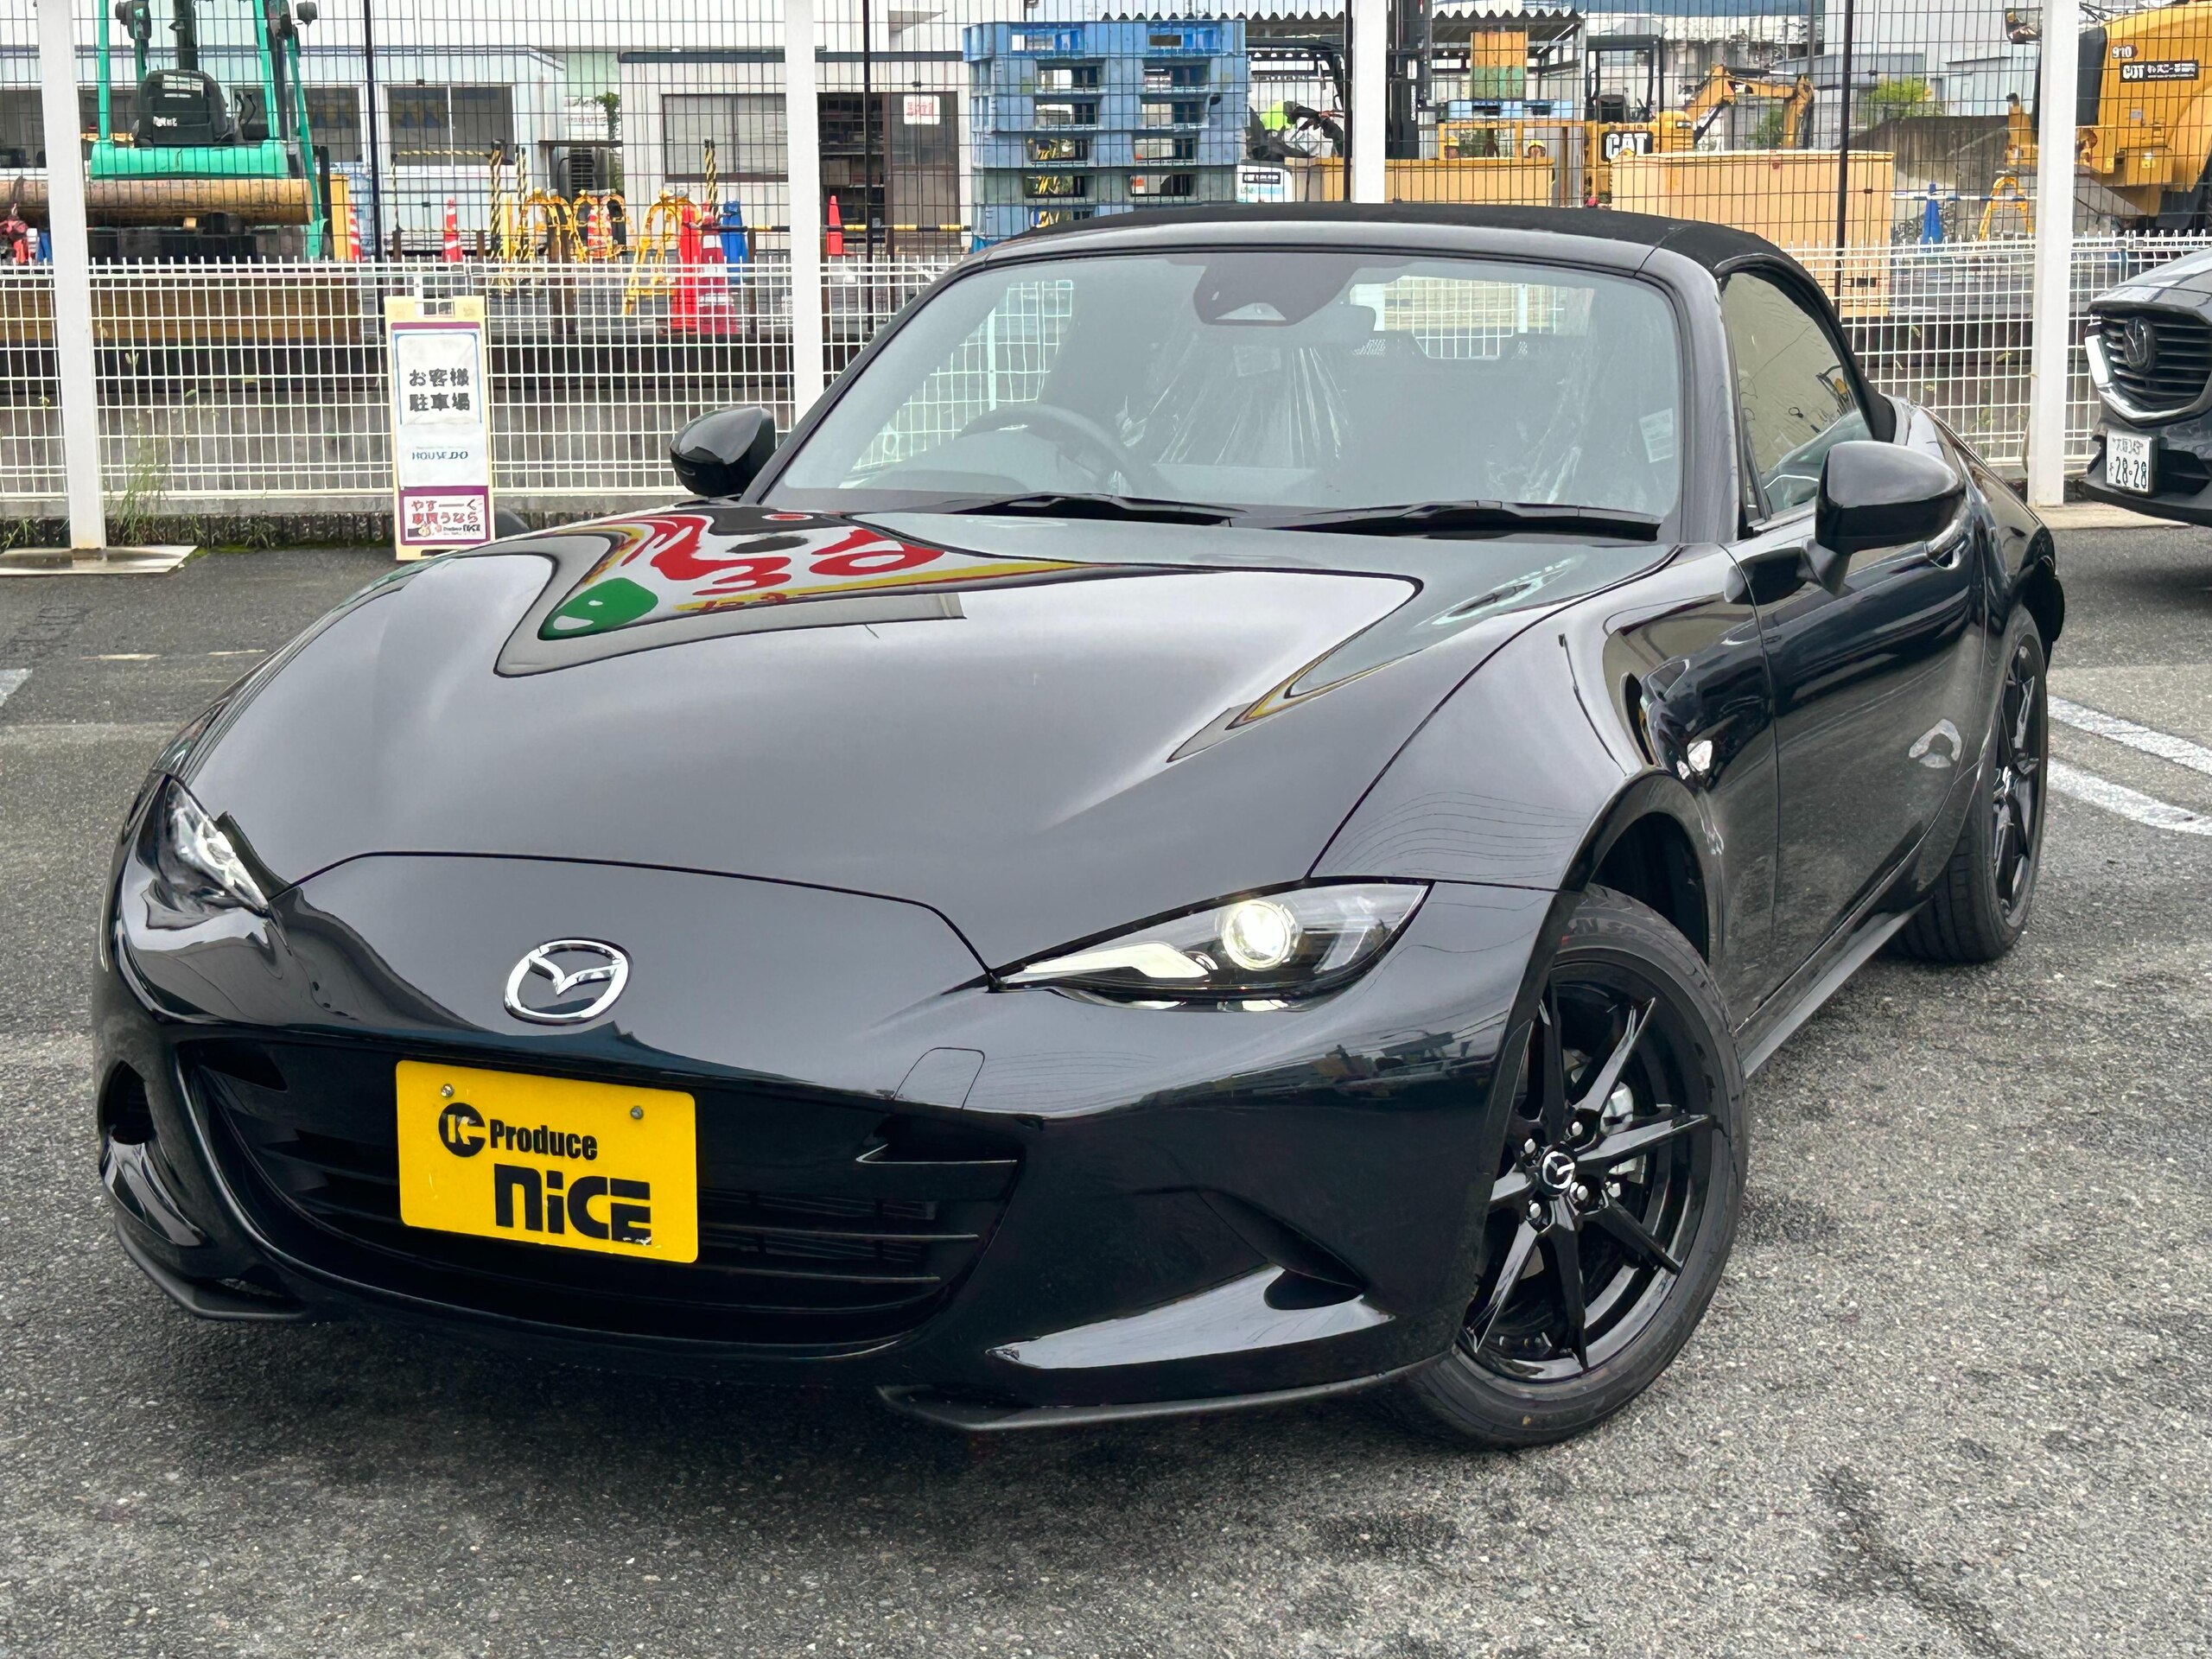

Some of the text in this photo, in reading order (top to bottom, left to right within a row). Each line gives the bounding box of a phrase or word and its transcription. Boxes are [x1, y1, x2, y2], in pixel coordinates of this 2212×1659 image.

[1605, 132, 1649, 159] CAT
[409, 368, 469, 387] お客様
[409, 392, 470, 411] 駐車場
[490, 1119, 598, 1160] Produce
